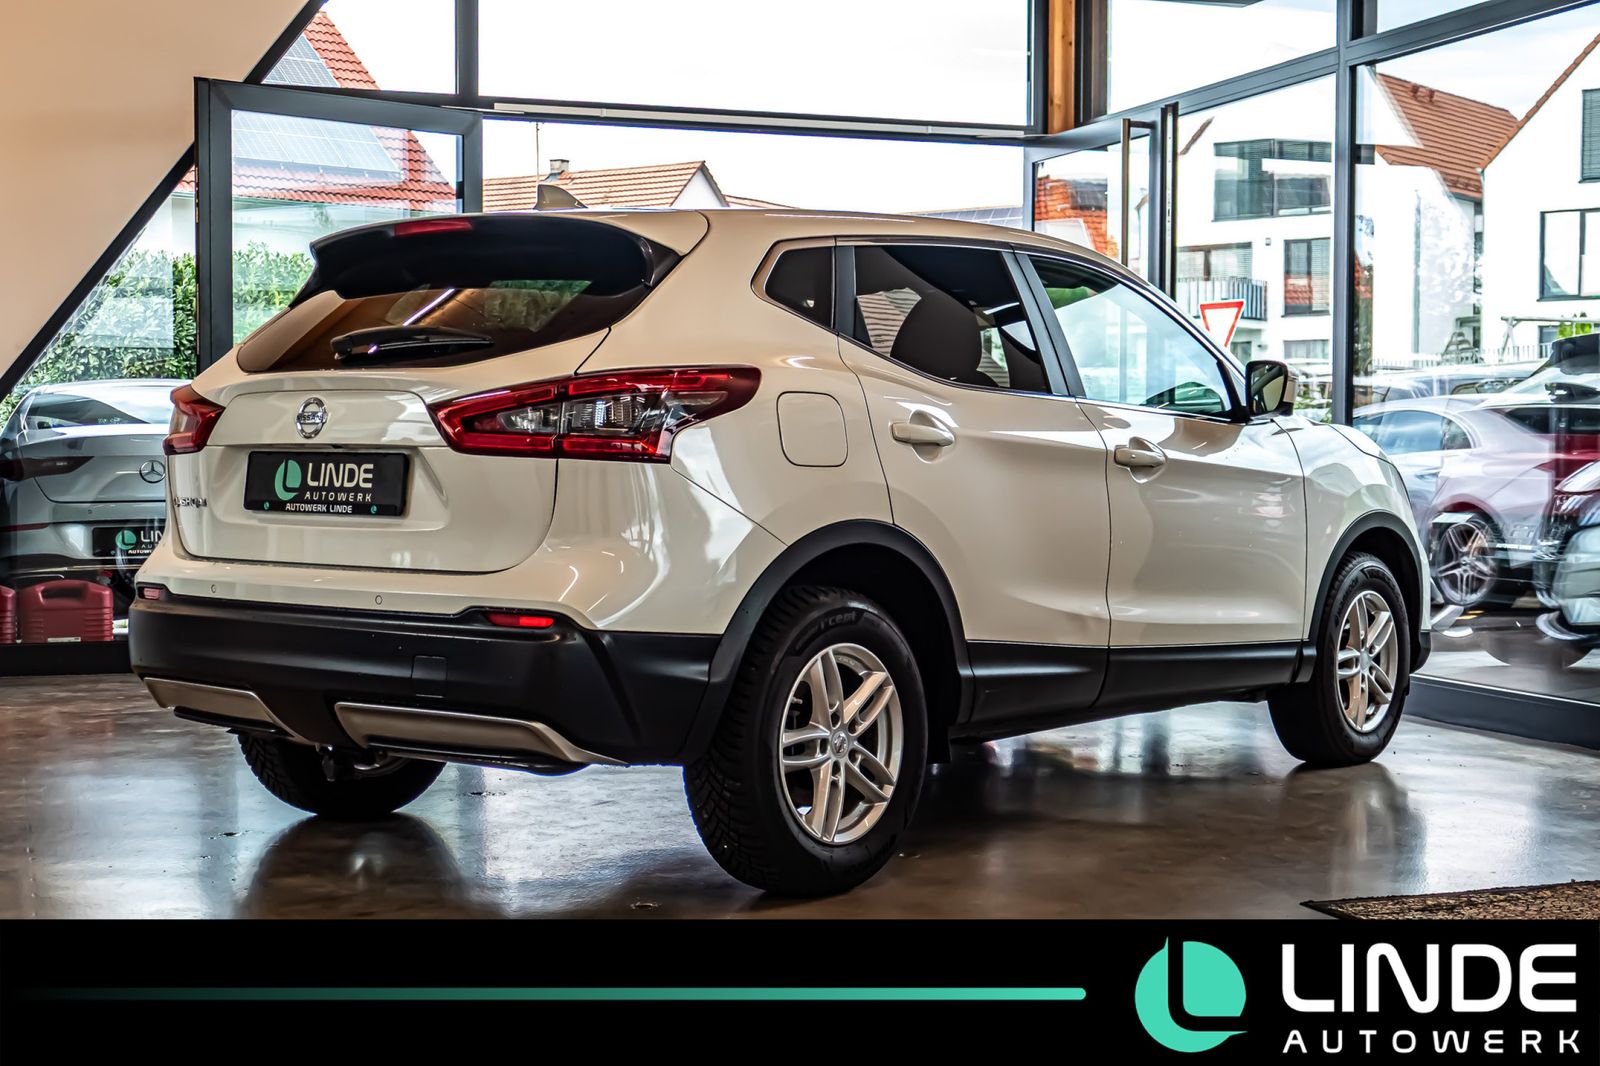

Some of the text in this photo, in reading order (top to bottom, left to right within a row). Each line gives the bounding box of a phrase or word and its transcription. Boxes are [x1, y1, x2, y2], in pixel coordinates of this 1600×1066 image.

[307, 462, 374, 488] LINDE
[304, 491, 373, 502] AUTOWERK
[285, 503, 353, 513] AUTOWERK LINDE
[140, 530, 164, 543] LIN
